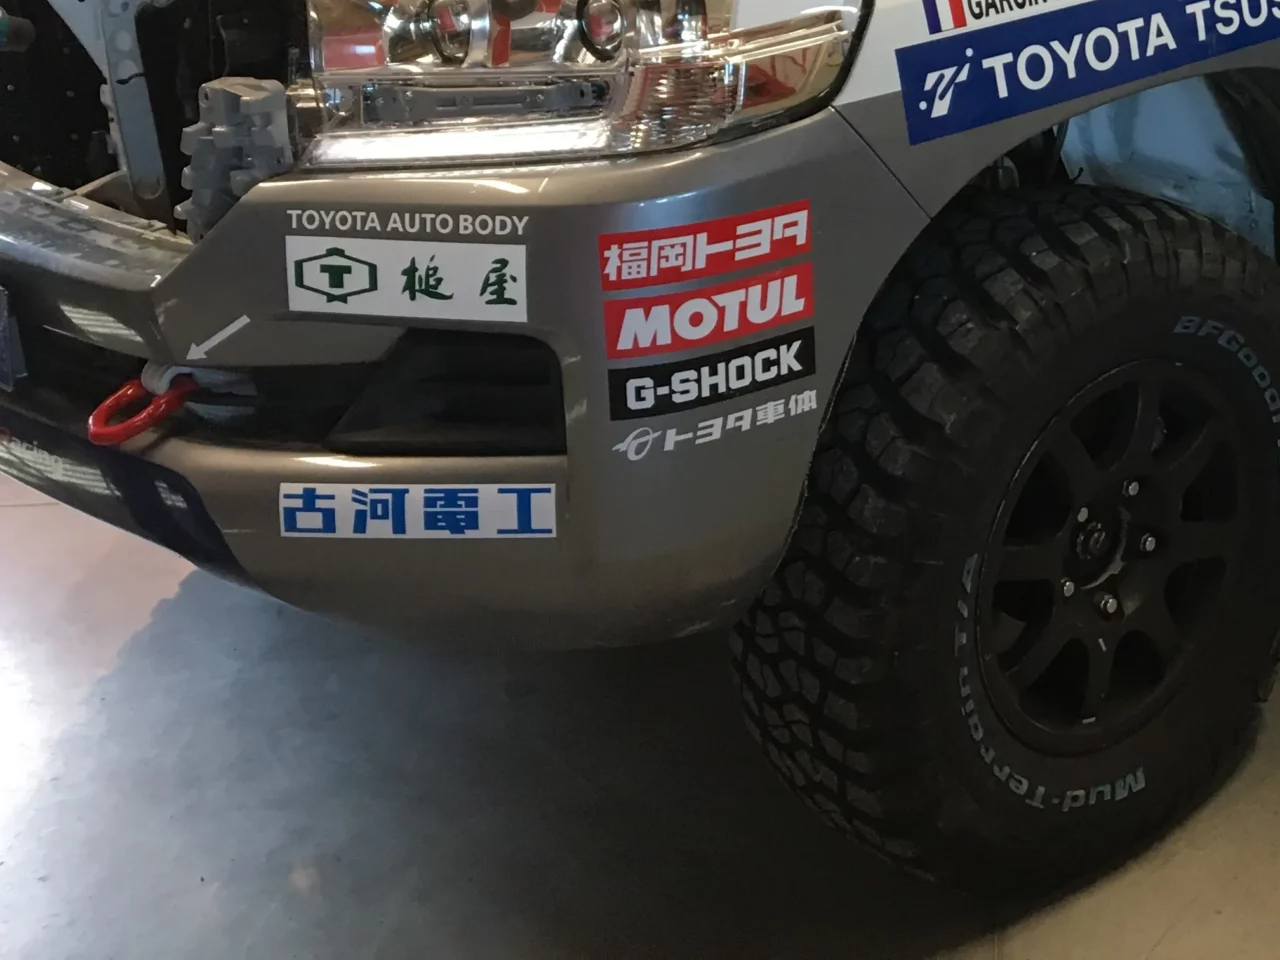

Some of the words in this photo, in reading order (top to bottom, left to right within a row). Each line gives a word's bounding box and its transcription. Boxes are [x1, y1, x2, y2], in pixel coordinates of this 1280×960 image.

[982, 12, 1178, 99] TOYOTA
[287, 209, 381, 232] TOYOTA
[386, 211, 454, 234] AUTO
[459, 214, 530, 236] BODY
[602, 209, 810, 282] 福岡トヨタ
[616, 273, 807, 351] MOTUL
[626, 339, 803, 411] G-SHOCK
[664, 389, 818, 453] トヨタ車体
[282, 486, 554, 536] 古河電工
